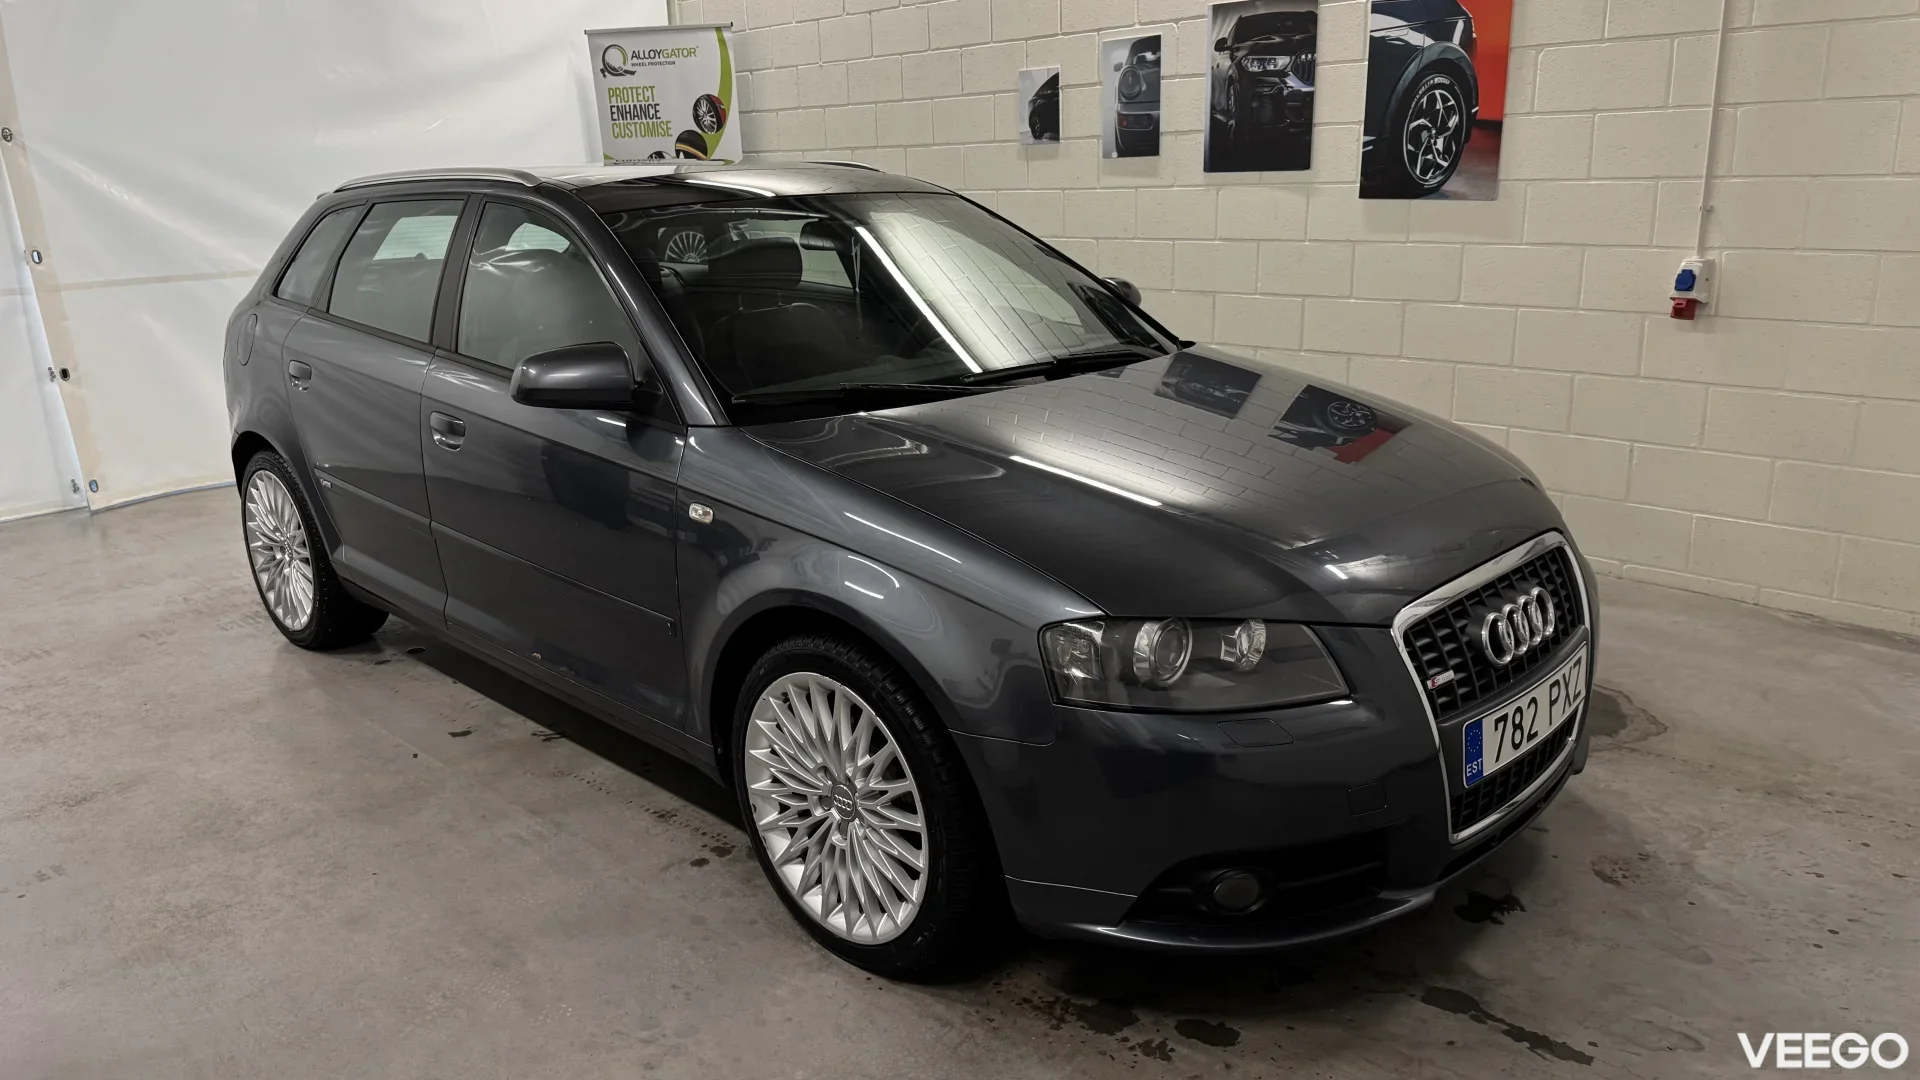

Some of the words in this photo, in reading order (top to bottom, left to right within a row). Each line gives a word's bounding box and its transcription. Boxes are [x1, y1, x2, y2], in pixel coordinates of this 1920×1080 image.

[608, 86, 655, 104] PROTECT
[610, 103, 661, 121] ENHANCE
[612, 121, 673, 139] CUSTOMISE
[1494, 697, 1538, 763] 782
[1549, 655, 1582, 727] PXZ
[1466, 758, 1482, 777] EST
